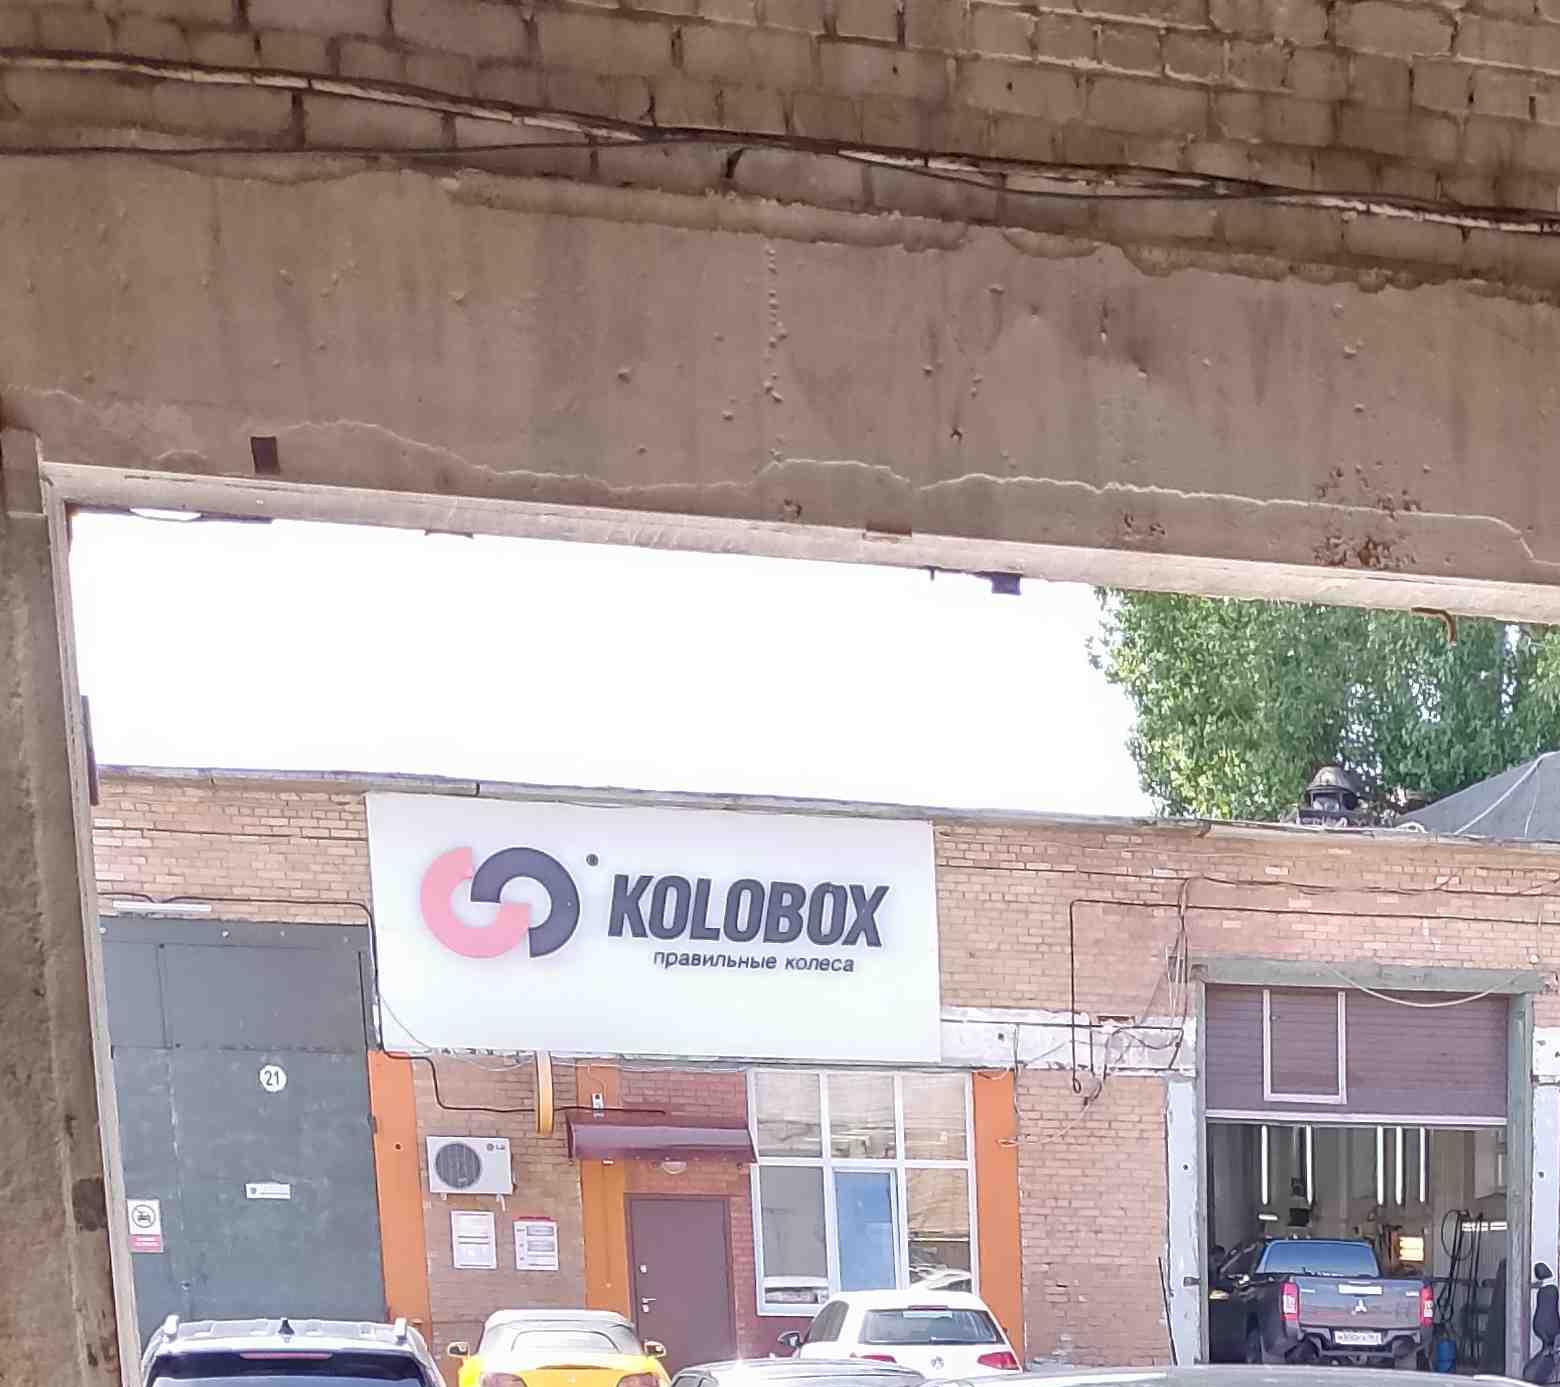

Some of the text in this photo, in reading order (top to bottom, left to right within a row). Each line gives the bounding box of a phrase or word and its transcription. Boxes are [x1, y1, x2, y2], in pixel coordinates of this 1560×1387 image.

[607, 874, 890, 947] KOLOBOX
[653, 950, 855, 972] правильные колеса
[264, 1070, 280, 1087] 21
